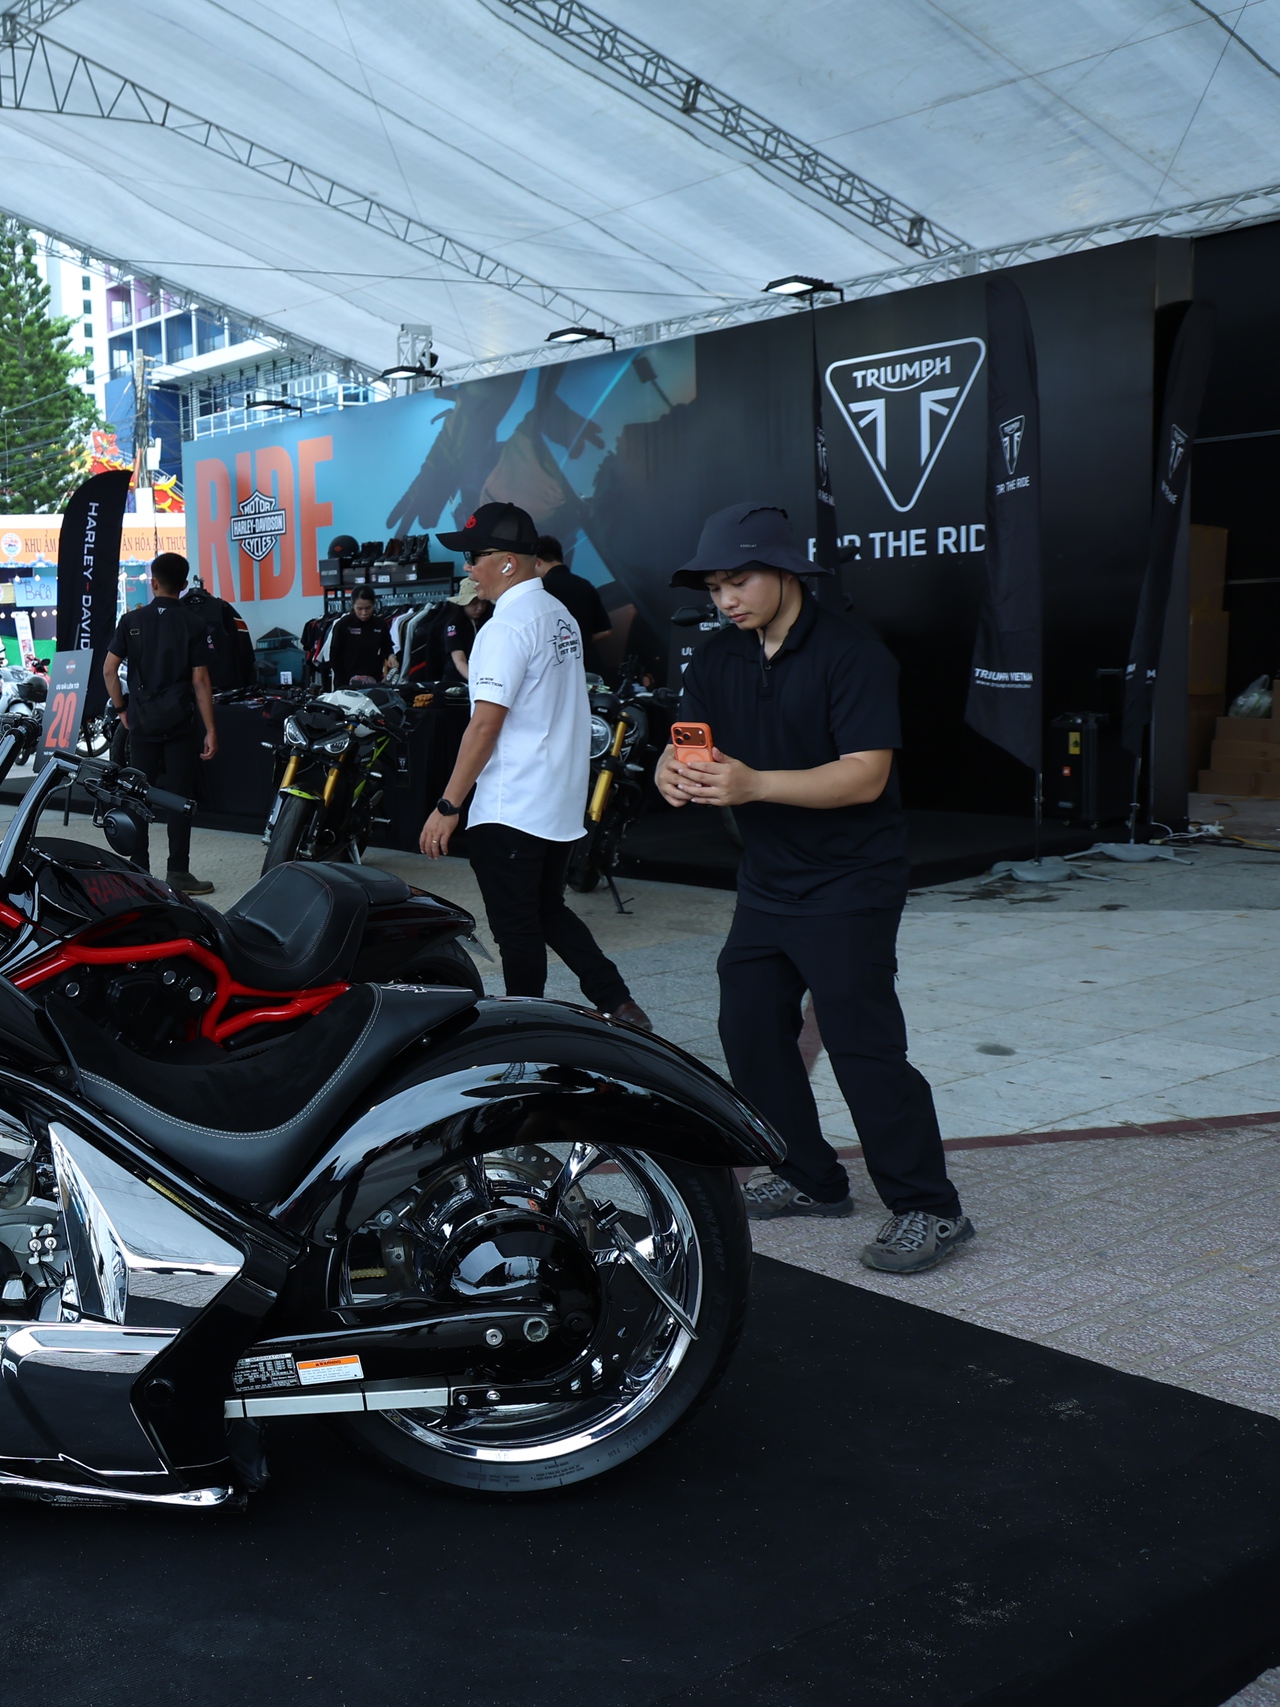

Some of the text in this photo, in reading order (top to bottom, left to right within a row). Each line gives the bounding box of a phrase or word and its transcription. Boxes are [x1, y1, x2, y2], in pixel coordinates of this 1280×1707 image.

[852, 355, 951, 390] TRIUMPH
[244, 497, 271, 515] MOTOR
[195, 435, 333, 602] RIDE
[233, 515, 283, 535] HARLEY-DAVIDSON
[24, 530, 57, 553] KHU ẨM
[122, 534, 133, 551] ĂN
[134, 532, 151, 551] HÓA
[245, 536, 272, 556] CYCLES
[808, 523, 986, 562] FR THE RID
